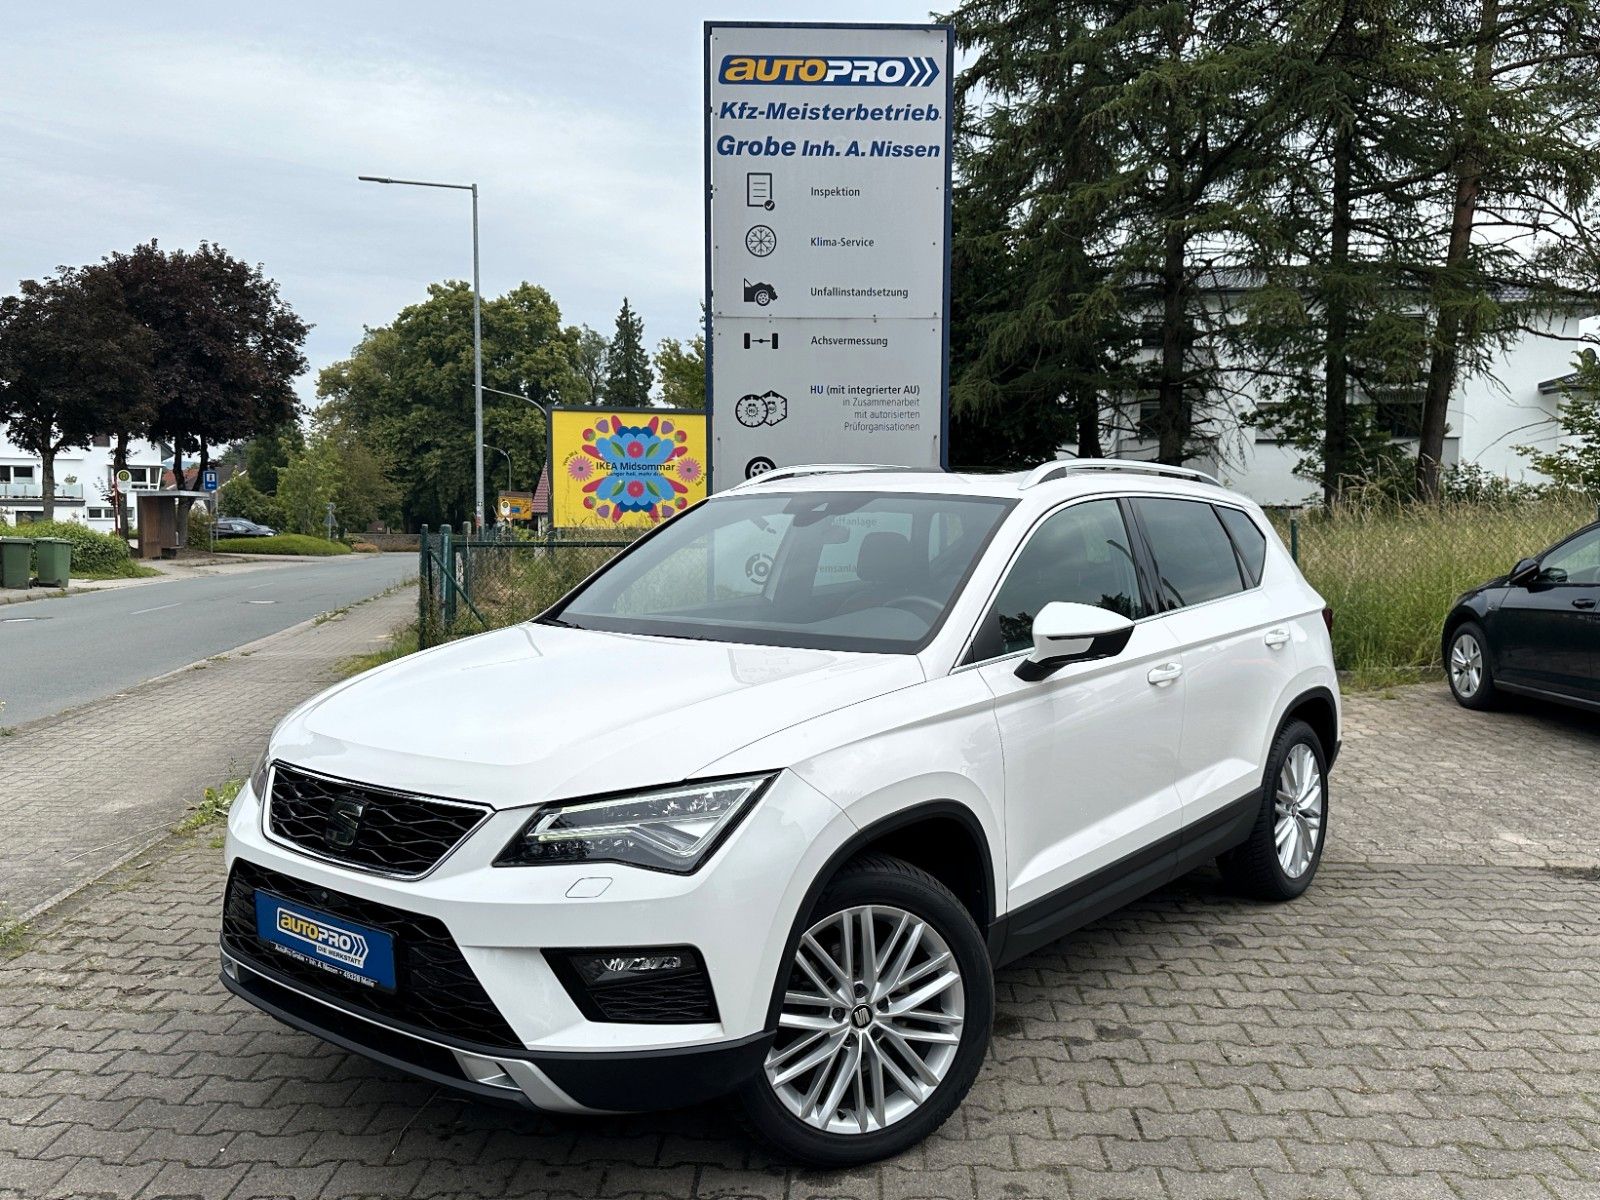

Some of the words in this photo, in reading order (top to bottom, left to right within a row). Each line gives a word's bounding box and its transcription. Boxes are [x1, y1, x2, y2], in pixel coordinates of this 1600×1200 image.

[719, 101, 939, 122] Kfz-Meisterbetrieb
[716, 135, 797, 156] Grobe
[801, 140, 841, 157] Inh.
[844, 141, 866, 157] A.
[869, 141, 941, 158] Nissen
[810, 187, 861, 199] Inspektion
[810, 237, 875, 247] Klima-Service
[810, 287, 909, 299] Unfallinstandsetzung
[810, 336, 888, 347] Achsvermessung
[810, 385, 824, 394] HU
[826, 385, 845, 396] (mit
[847, 385, 902, 397] integrierter
[903, 385, 921, 396] AU)
[842, 398, 851, 406] in
[852, 398, 920, 407] Zusammenarbeit
[854, 410, 868, 419] mit
[869, 410, 920, 419] autorisierten
[844, 422, 921, 434] Prüforganisationen
[596, 462, 618, 470] IKEA
[620, 462, 676, 471] Midsommar
[317, 945, 328, 954] DIE
[327, 948, 362, 965] WERKSTATT
